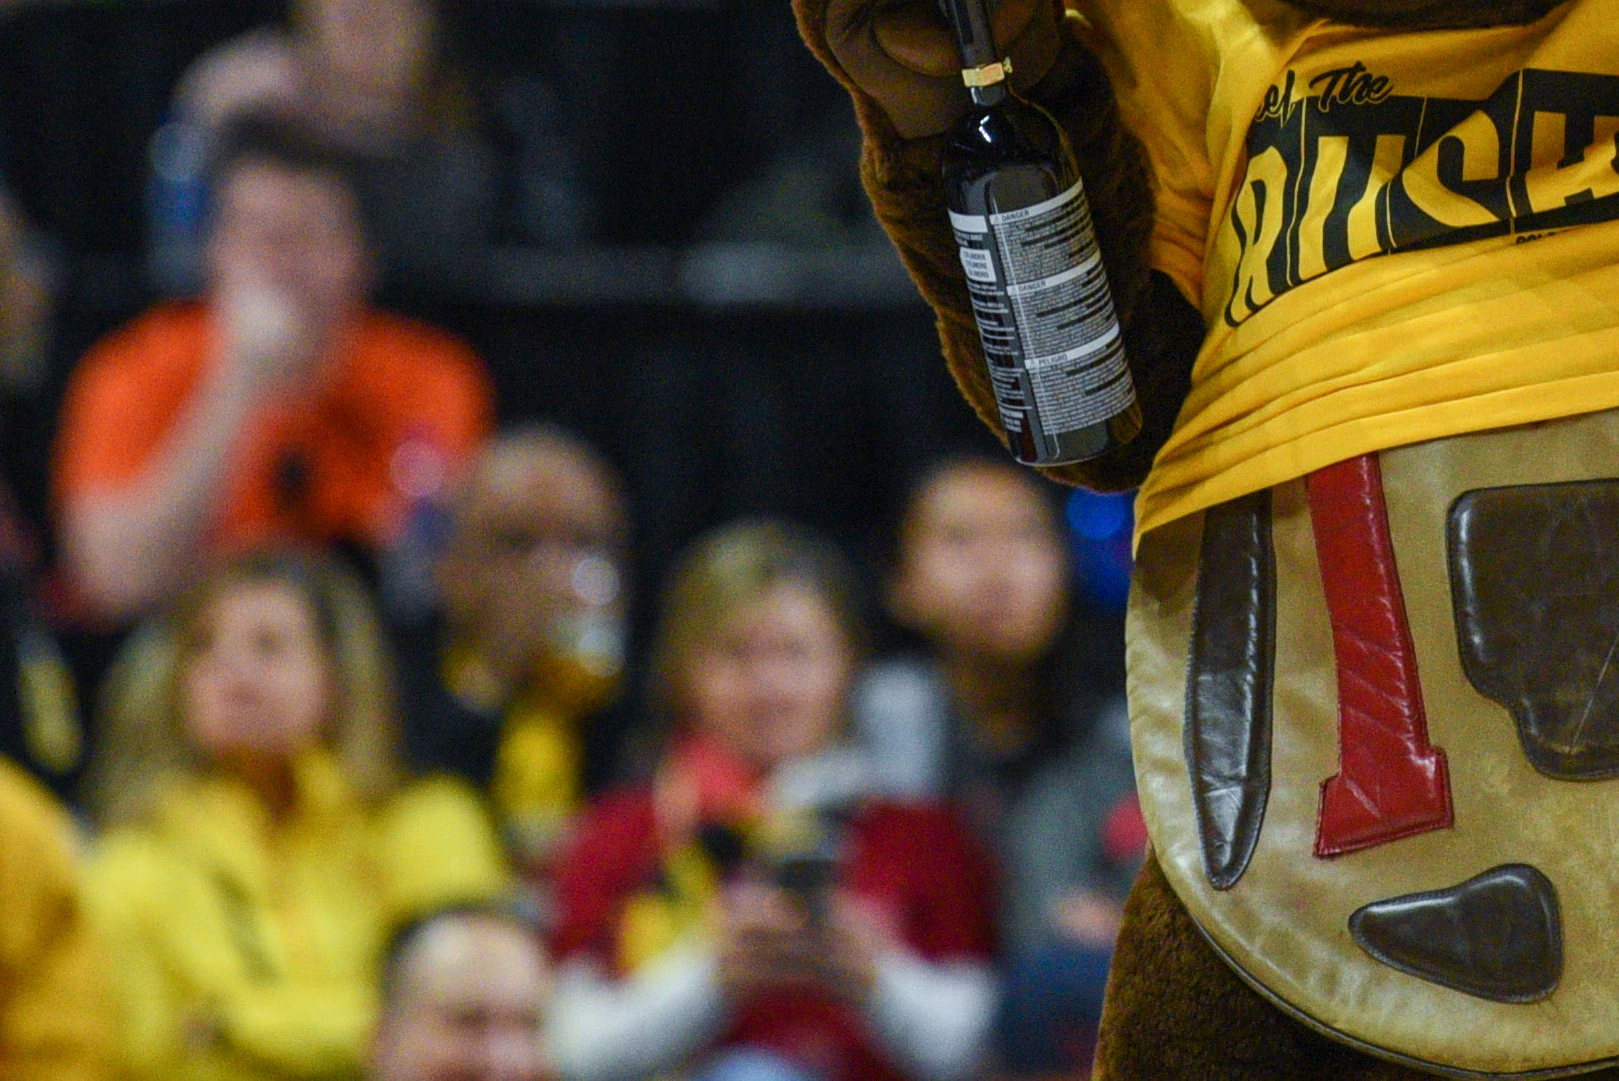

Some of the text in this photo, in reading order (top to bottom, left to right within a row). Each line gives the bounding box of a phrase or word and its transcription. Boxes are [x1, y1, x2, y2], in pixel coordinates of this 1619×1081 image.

[1308, 60, 1395, 113] The
[1001, 210, 1030, 222] DANGER
[1018, 281, 1047, 292] DANGER
[1038, 354, 1068, 366] PELIGRO
